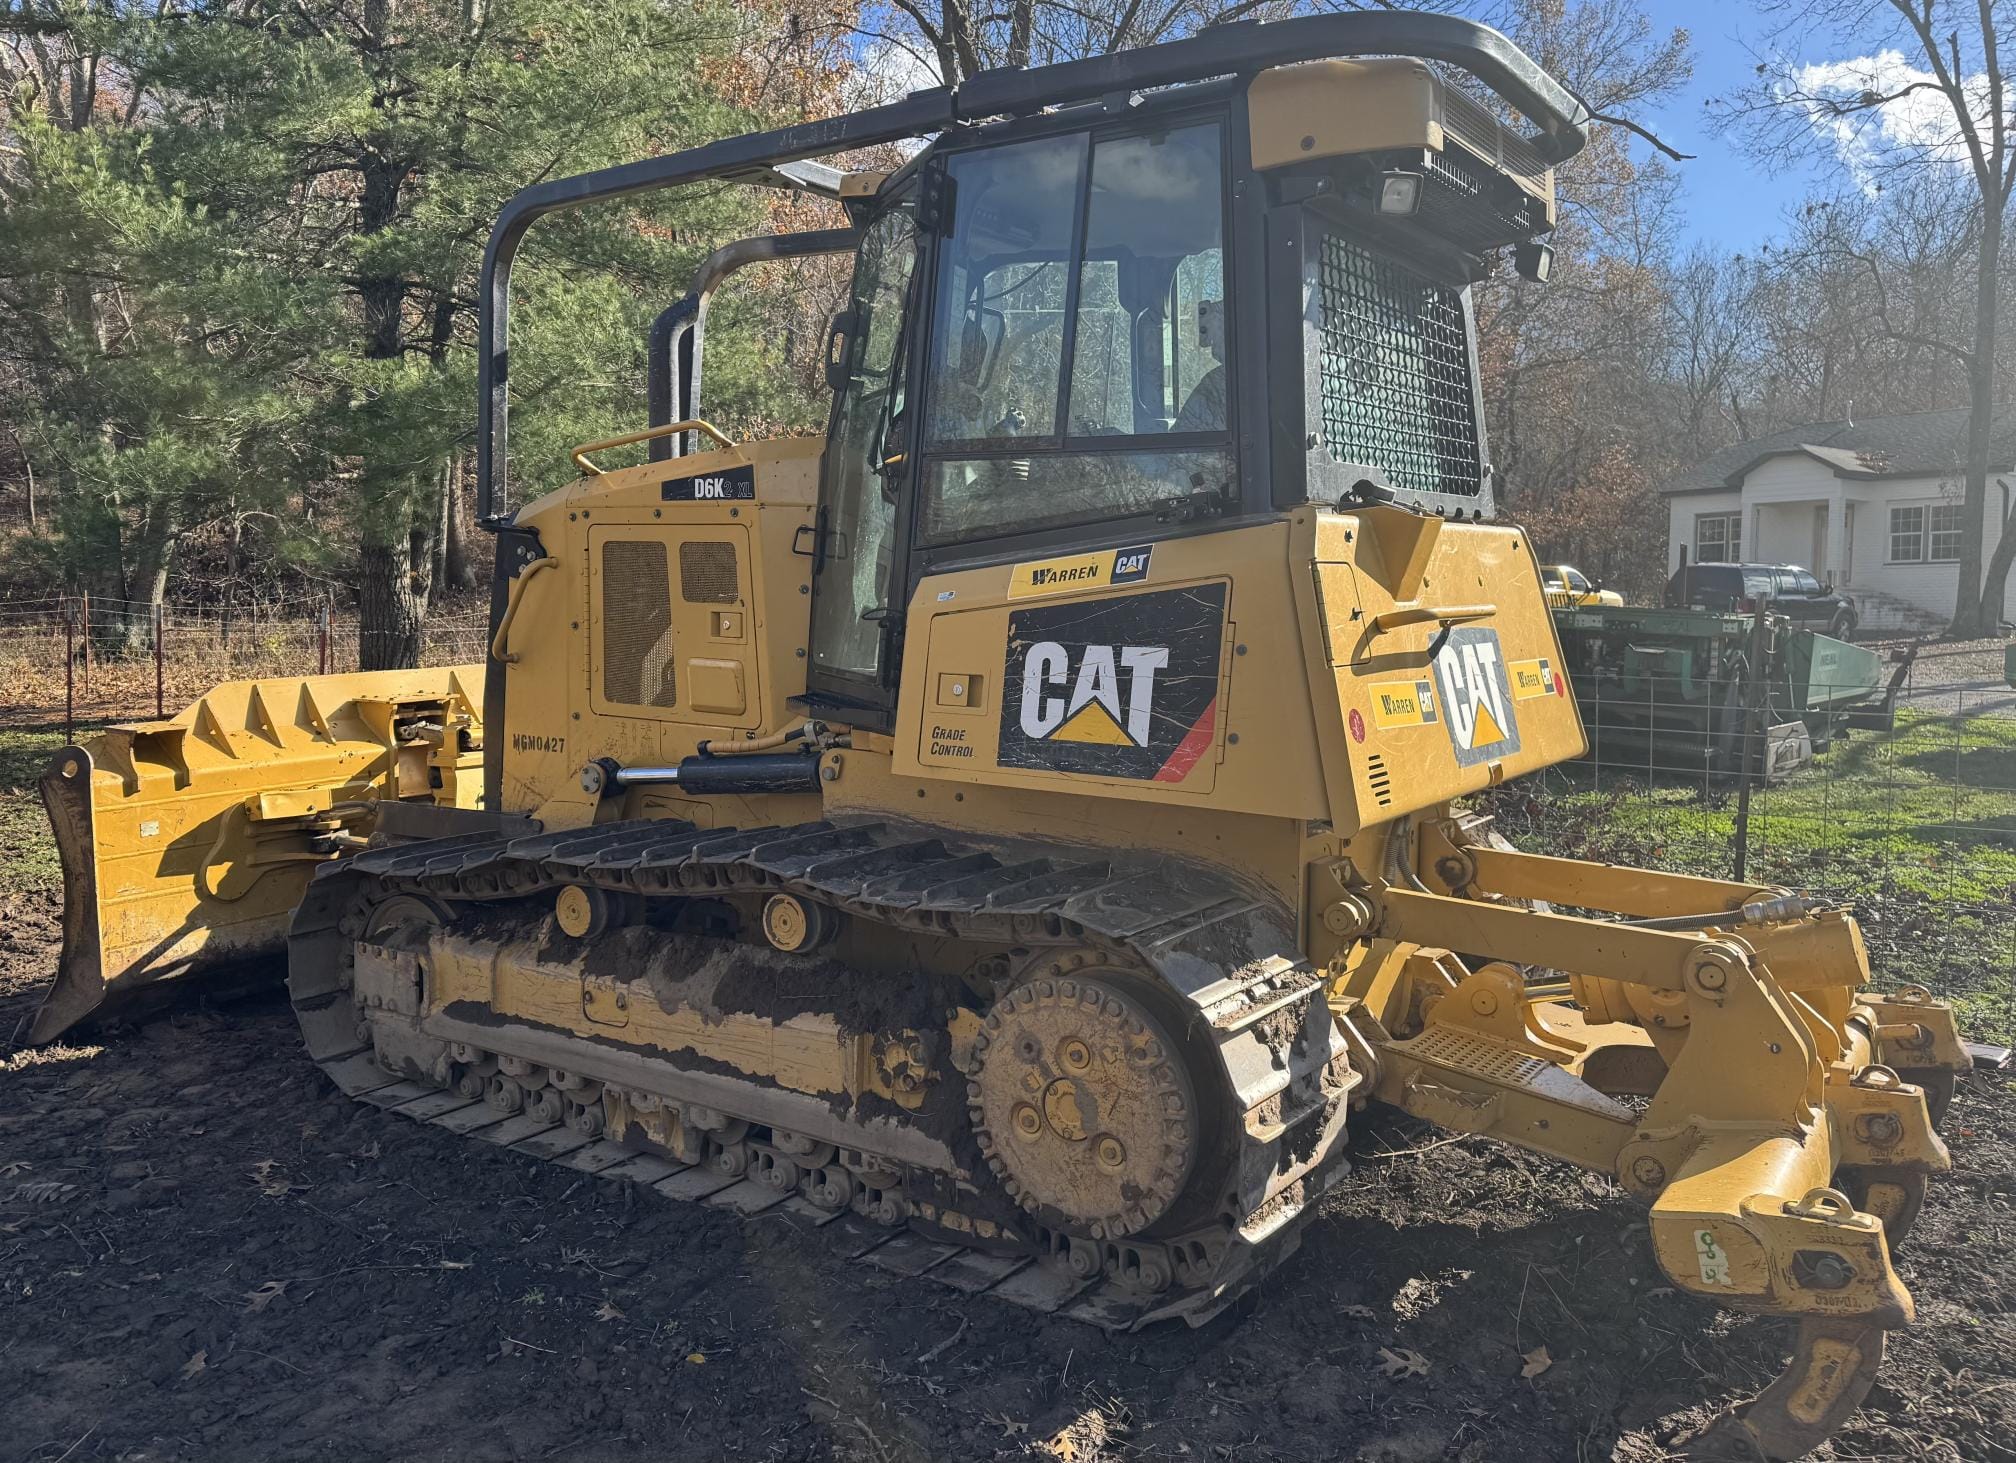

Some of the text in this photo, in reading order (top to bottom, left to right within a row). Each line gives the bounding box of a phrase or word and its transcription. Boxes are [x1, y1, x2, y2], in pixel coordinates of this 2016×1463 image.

[1032, 554, 1149, 586] WARREN CAT
[1020, 641, 1169, 748] CAT
[1380, 691, 1434, 716] WARREN CAT
[1438, 642, 1510, 750] CAT
[931, 725, 966, 741] GRADE
[930, 741, 974, 758] CONTROL
